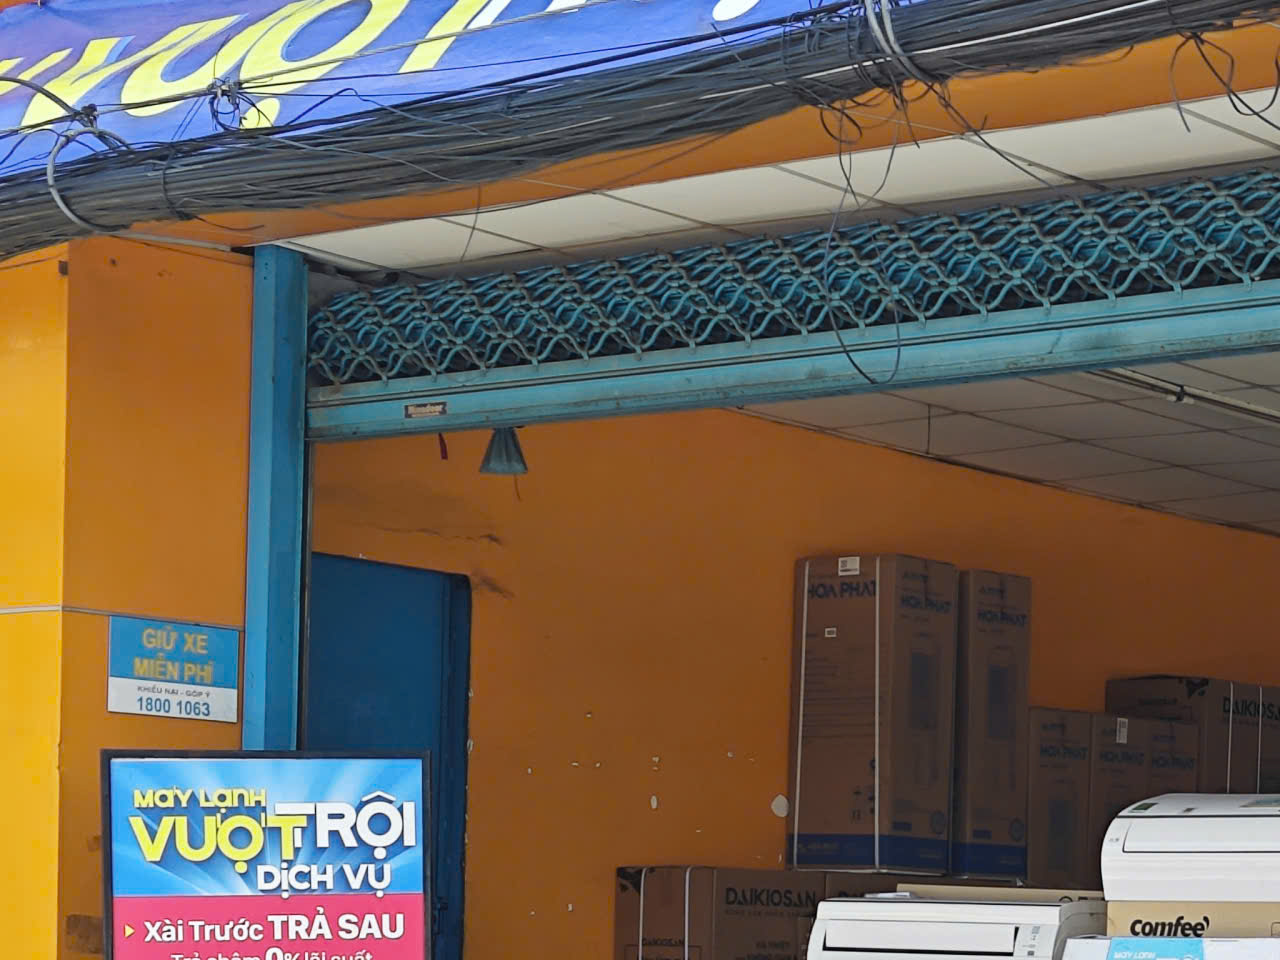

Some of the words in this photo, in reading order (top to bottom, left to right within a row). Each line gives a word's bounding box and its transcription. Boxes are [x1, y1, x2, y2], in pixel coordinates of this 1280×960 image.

[184, 632, 209, 654] XE
[184, 659, 214, 684] PHÍ
[137, 696, 171, 713] 1800
[176, 700, 211, 717] 1063
[344, 863, 392, 898] VỤ
[725, 887, 817, 908] DAIKIOSAN
[144, 919, 185, 942] Xài
[188, 919, 263, 942] Trước
[268, 907, 333, 940] TRẢ
[338, 913, 404, 940] SAU
